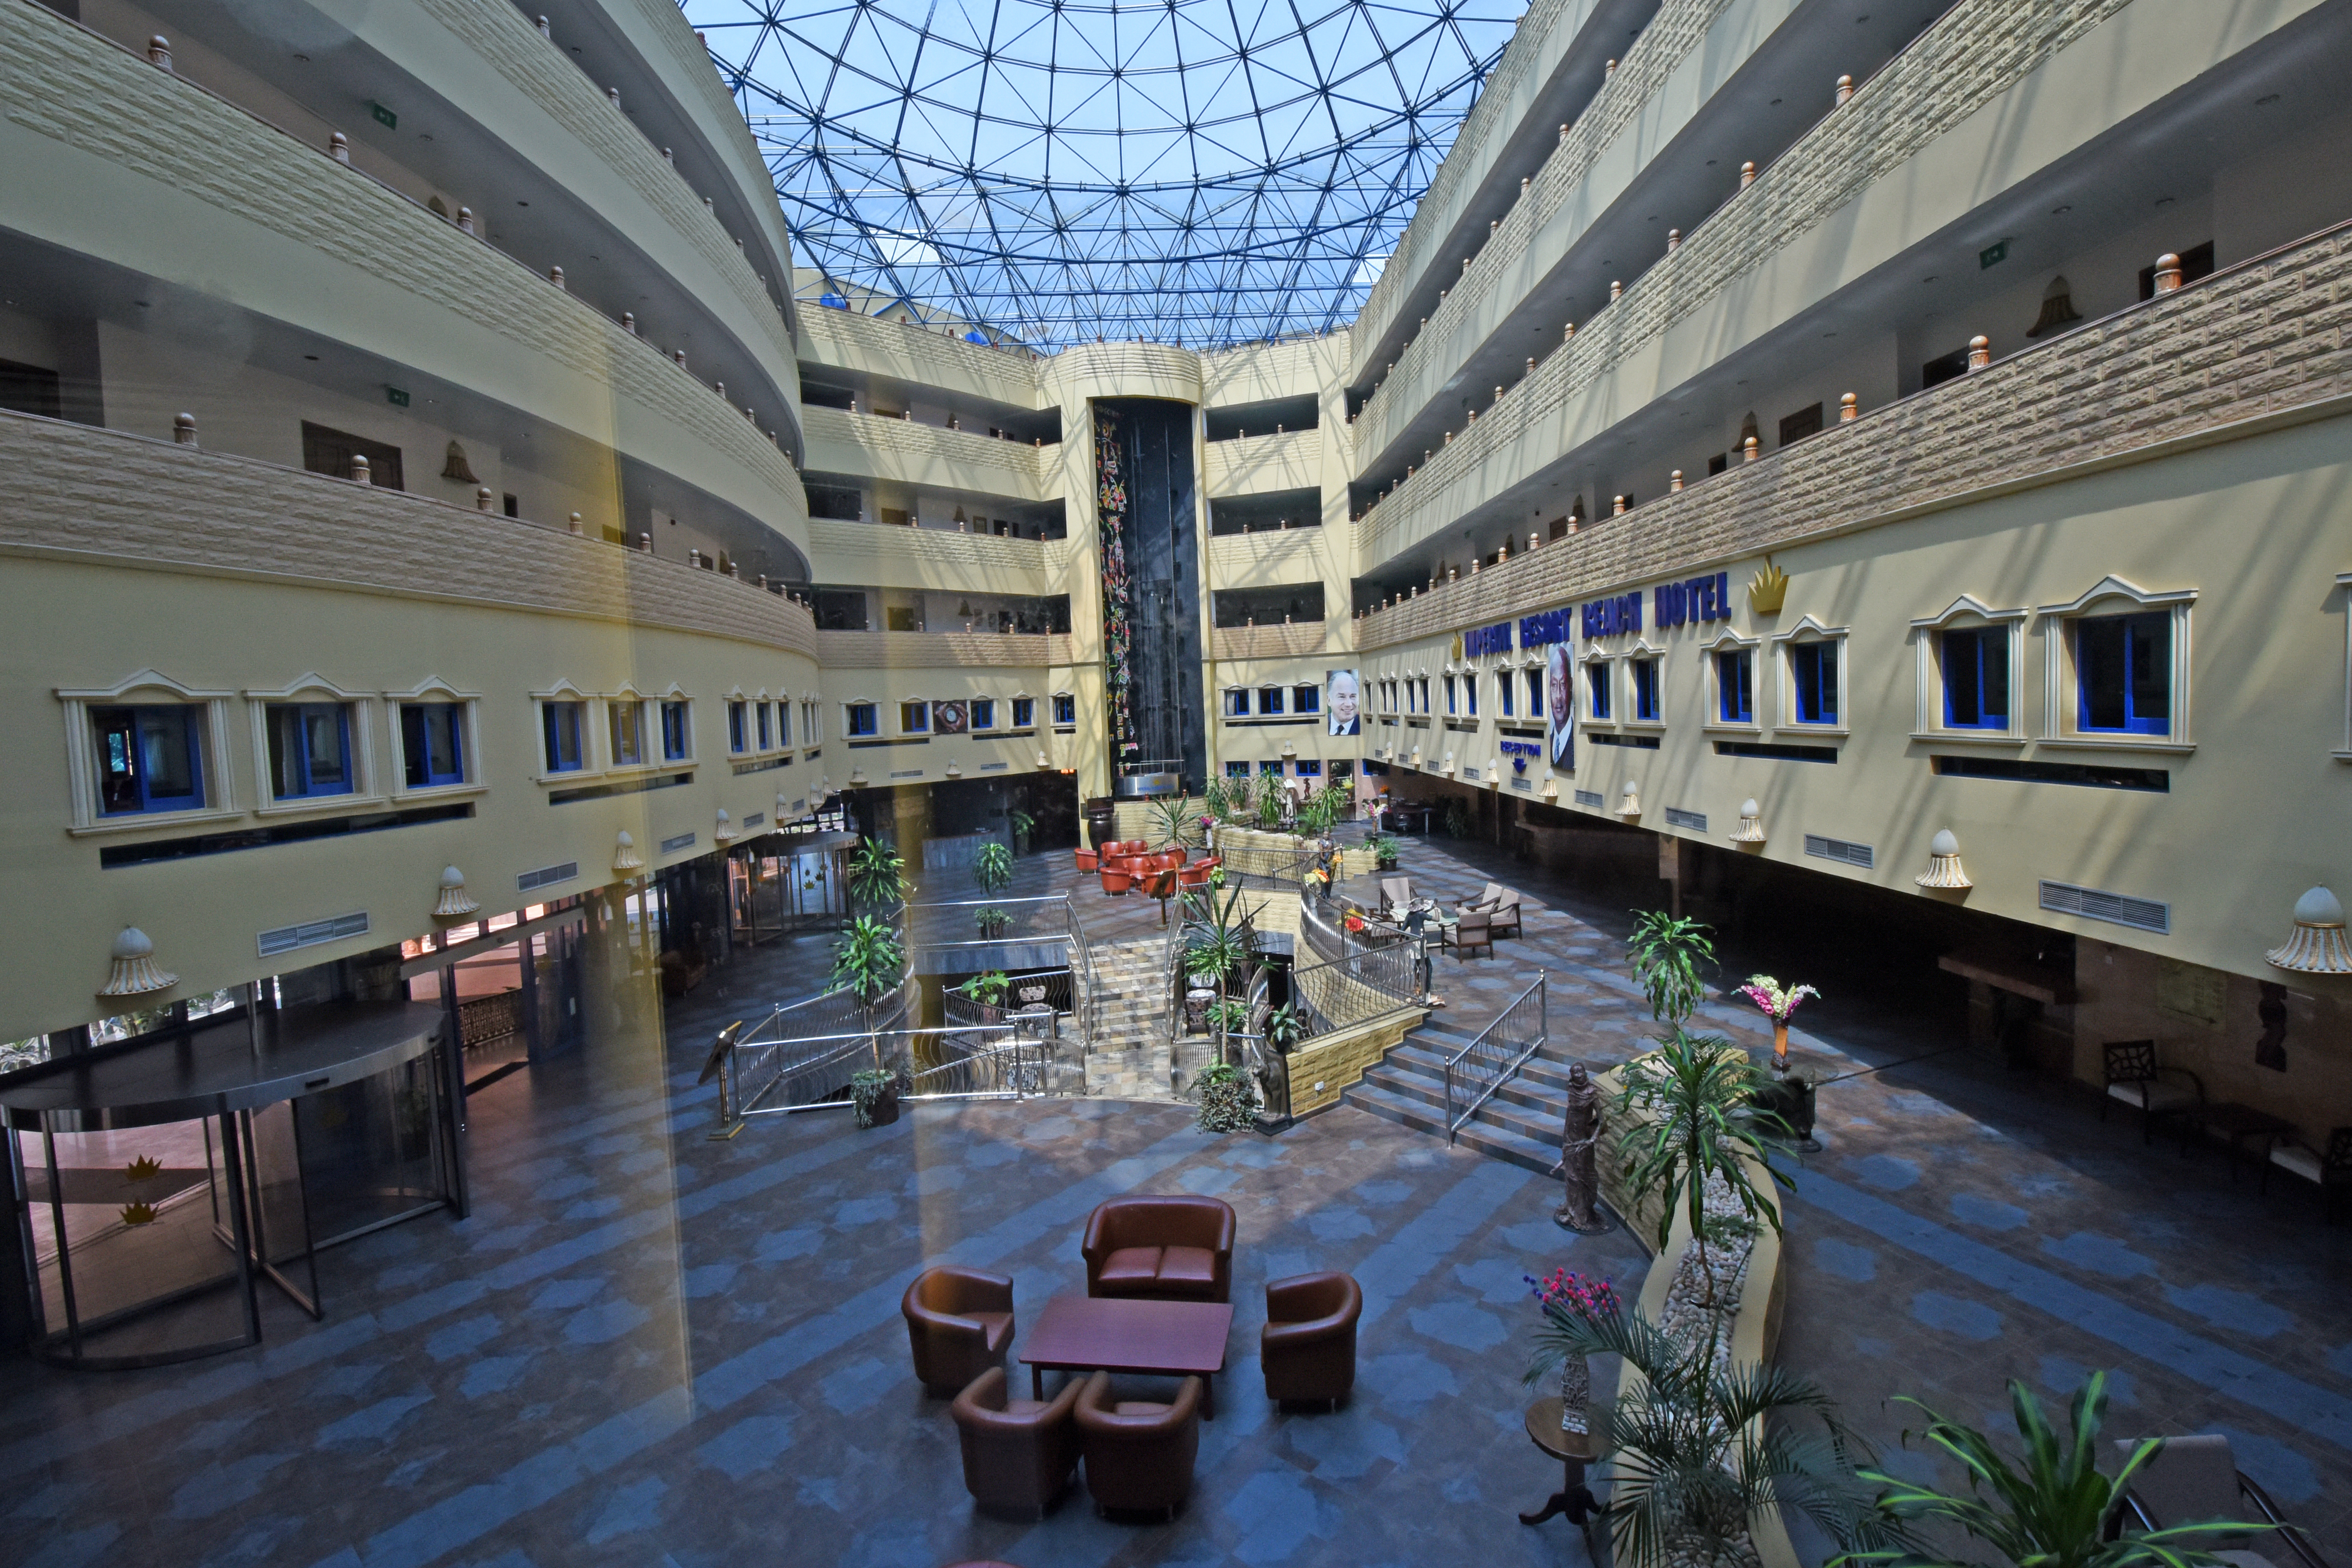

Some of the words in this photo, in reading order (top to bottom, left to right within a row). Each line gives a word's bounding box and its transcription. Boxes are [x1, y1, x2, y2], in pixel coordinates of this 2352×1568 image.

[1519, 607, 1571, 649] RESORT
[1582, 591, 1642, 638] BEACH
[1655, 572, 1731, 628] HOTEL
[1500, 740, 1541, 757] RECEPTION
